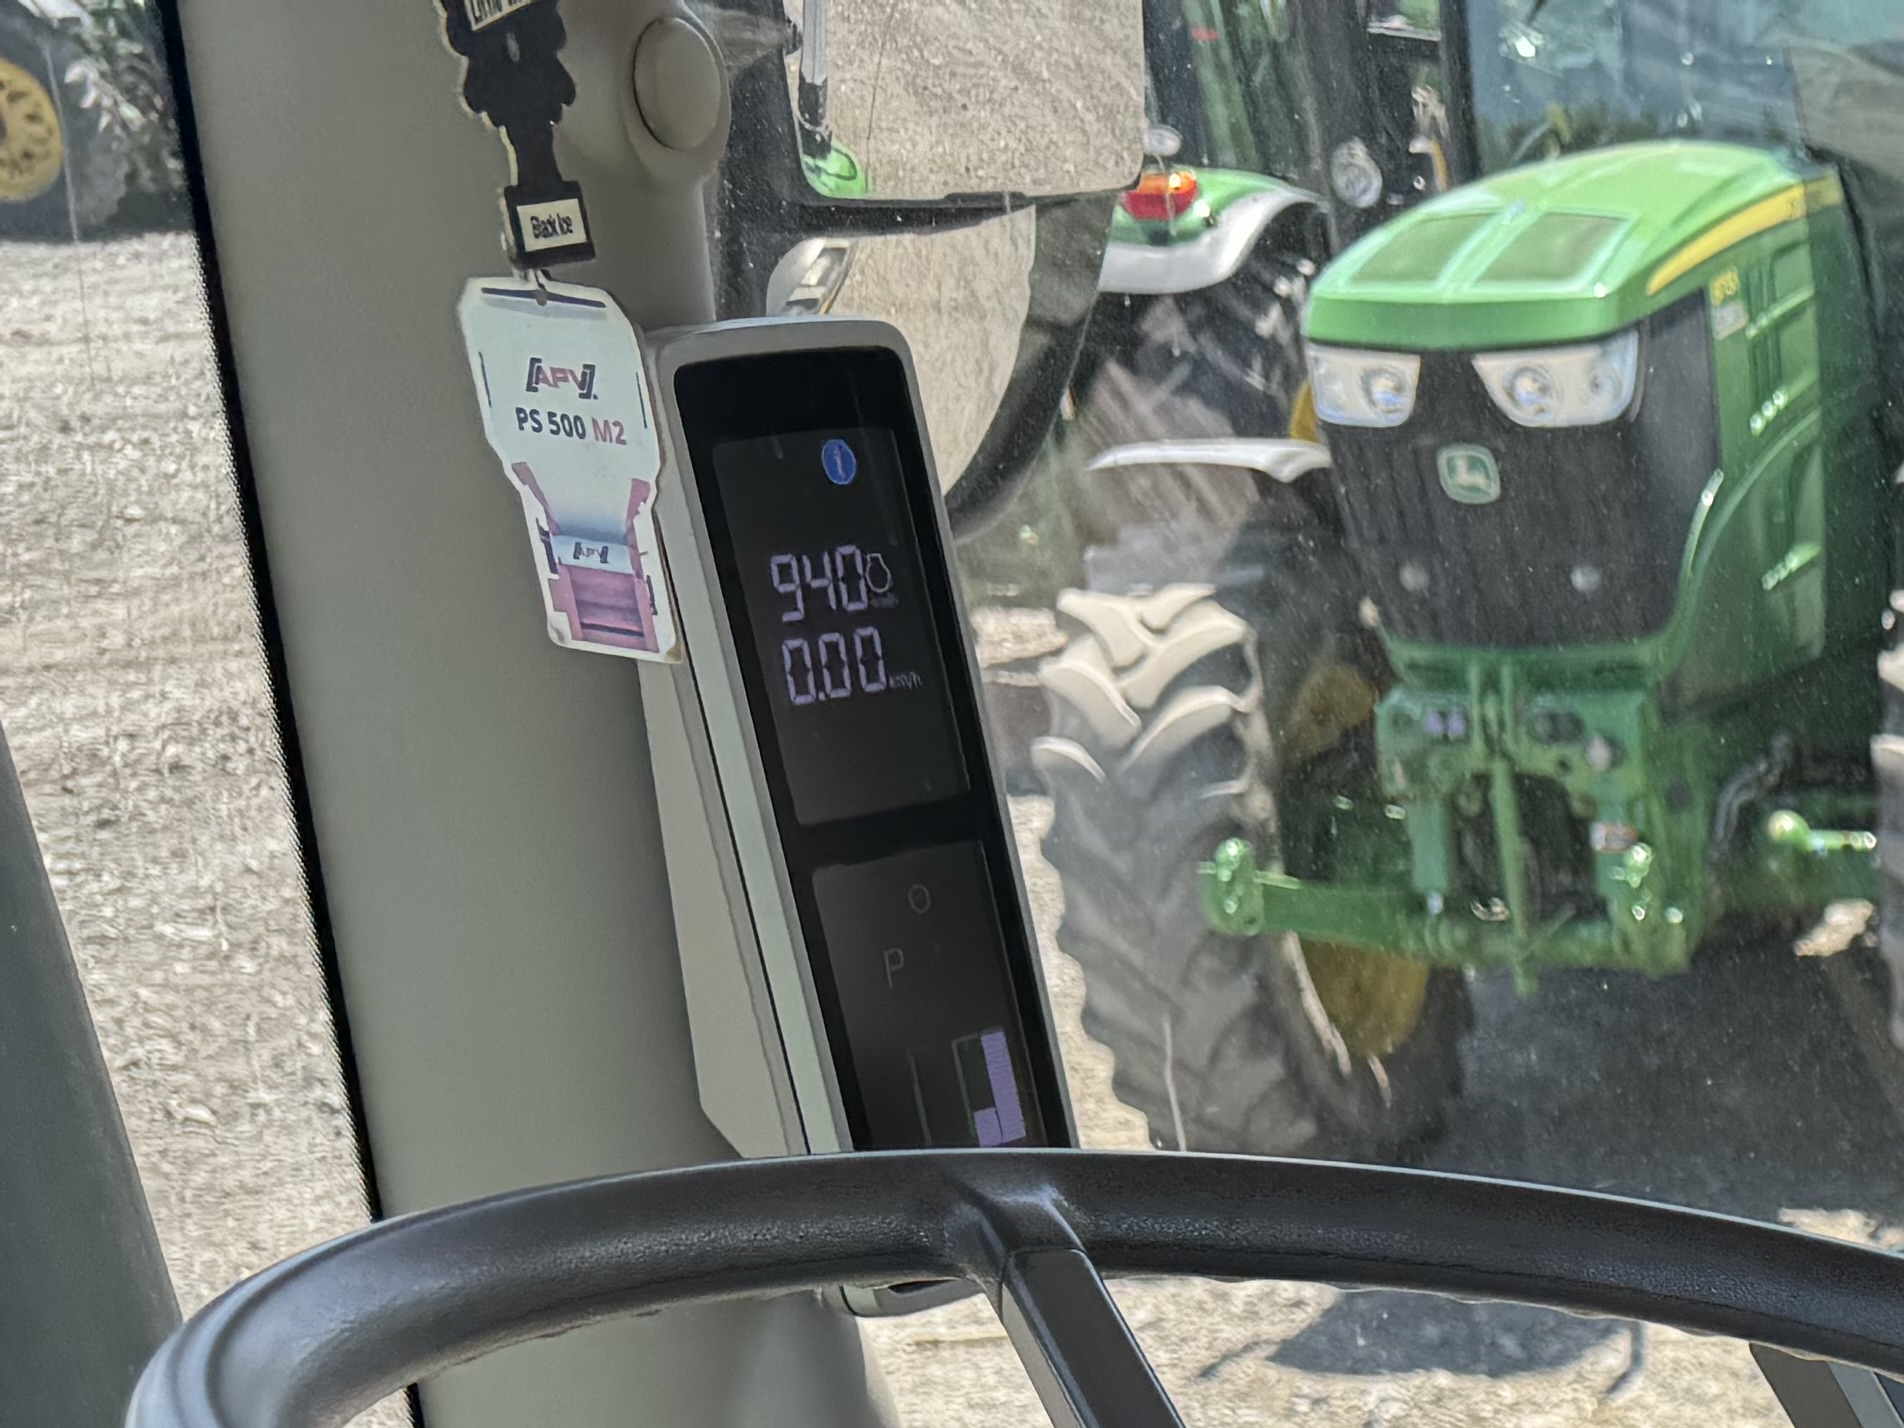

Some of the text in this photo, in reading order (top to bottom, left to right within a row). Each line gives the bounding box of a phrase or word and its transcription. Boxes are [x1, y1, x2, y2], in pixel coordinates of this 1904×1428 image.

[515, 407, 627, 445] PS 500 M2
[770, 544, 868, 622] 940
[781, 626, 887, 705] 0.00
